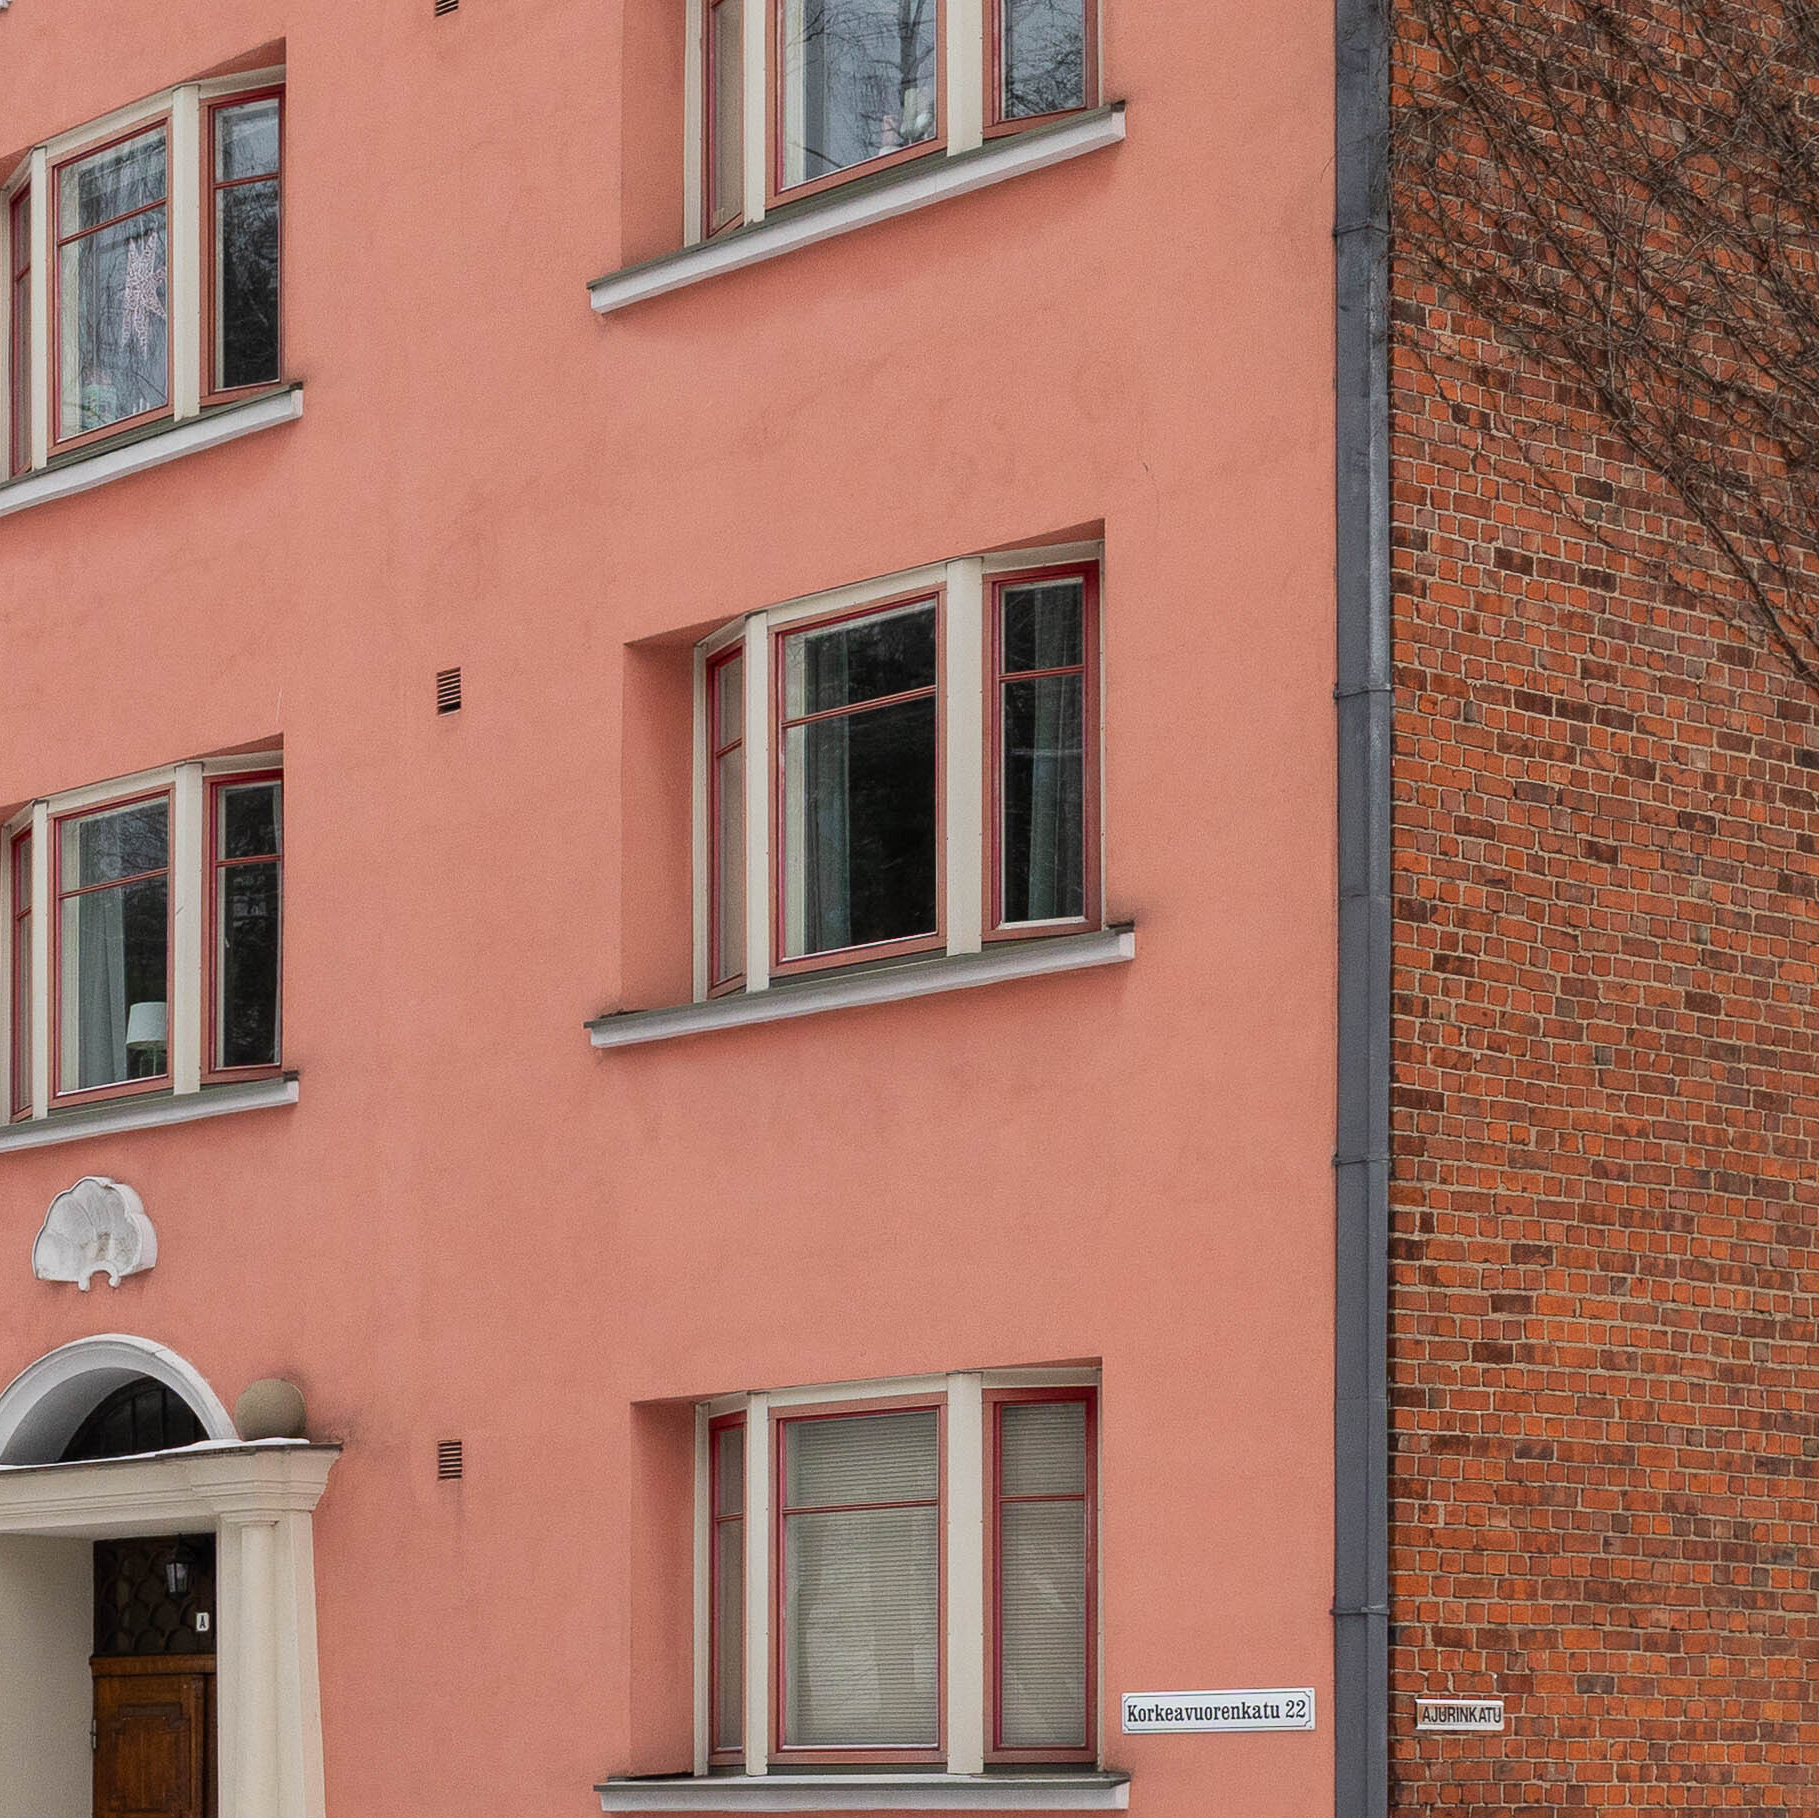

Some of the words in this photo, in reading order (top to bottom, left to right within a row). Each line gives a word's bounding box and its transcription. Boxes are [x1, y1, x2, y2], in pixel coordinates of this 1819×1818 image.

[199, 1614, 207, 1629] A
[1127, 1702, 1281, 1723] Korkeavuorenkatu
[1285, 1700, 1307, 1719] 22
[1422, 1706, 1502, 1724] AJURINKATU
